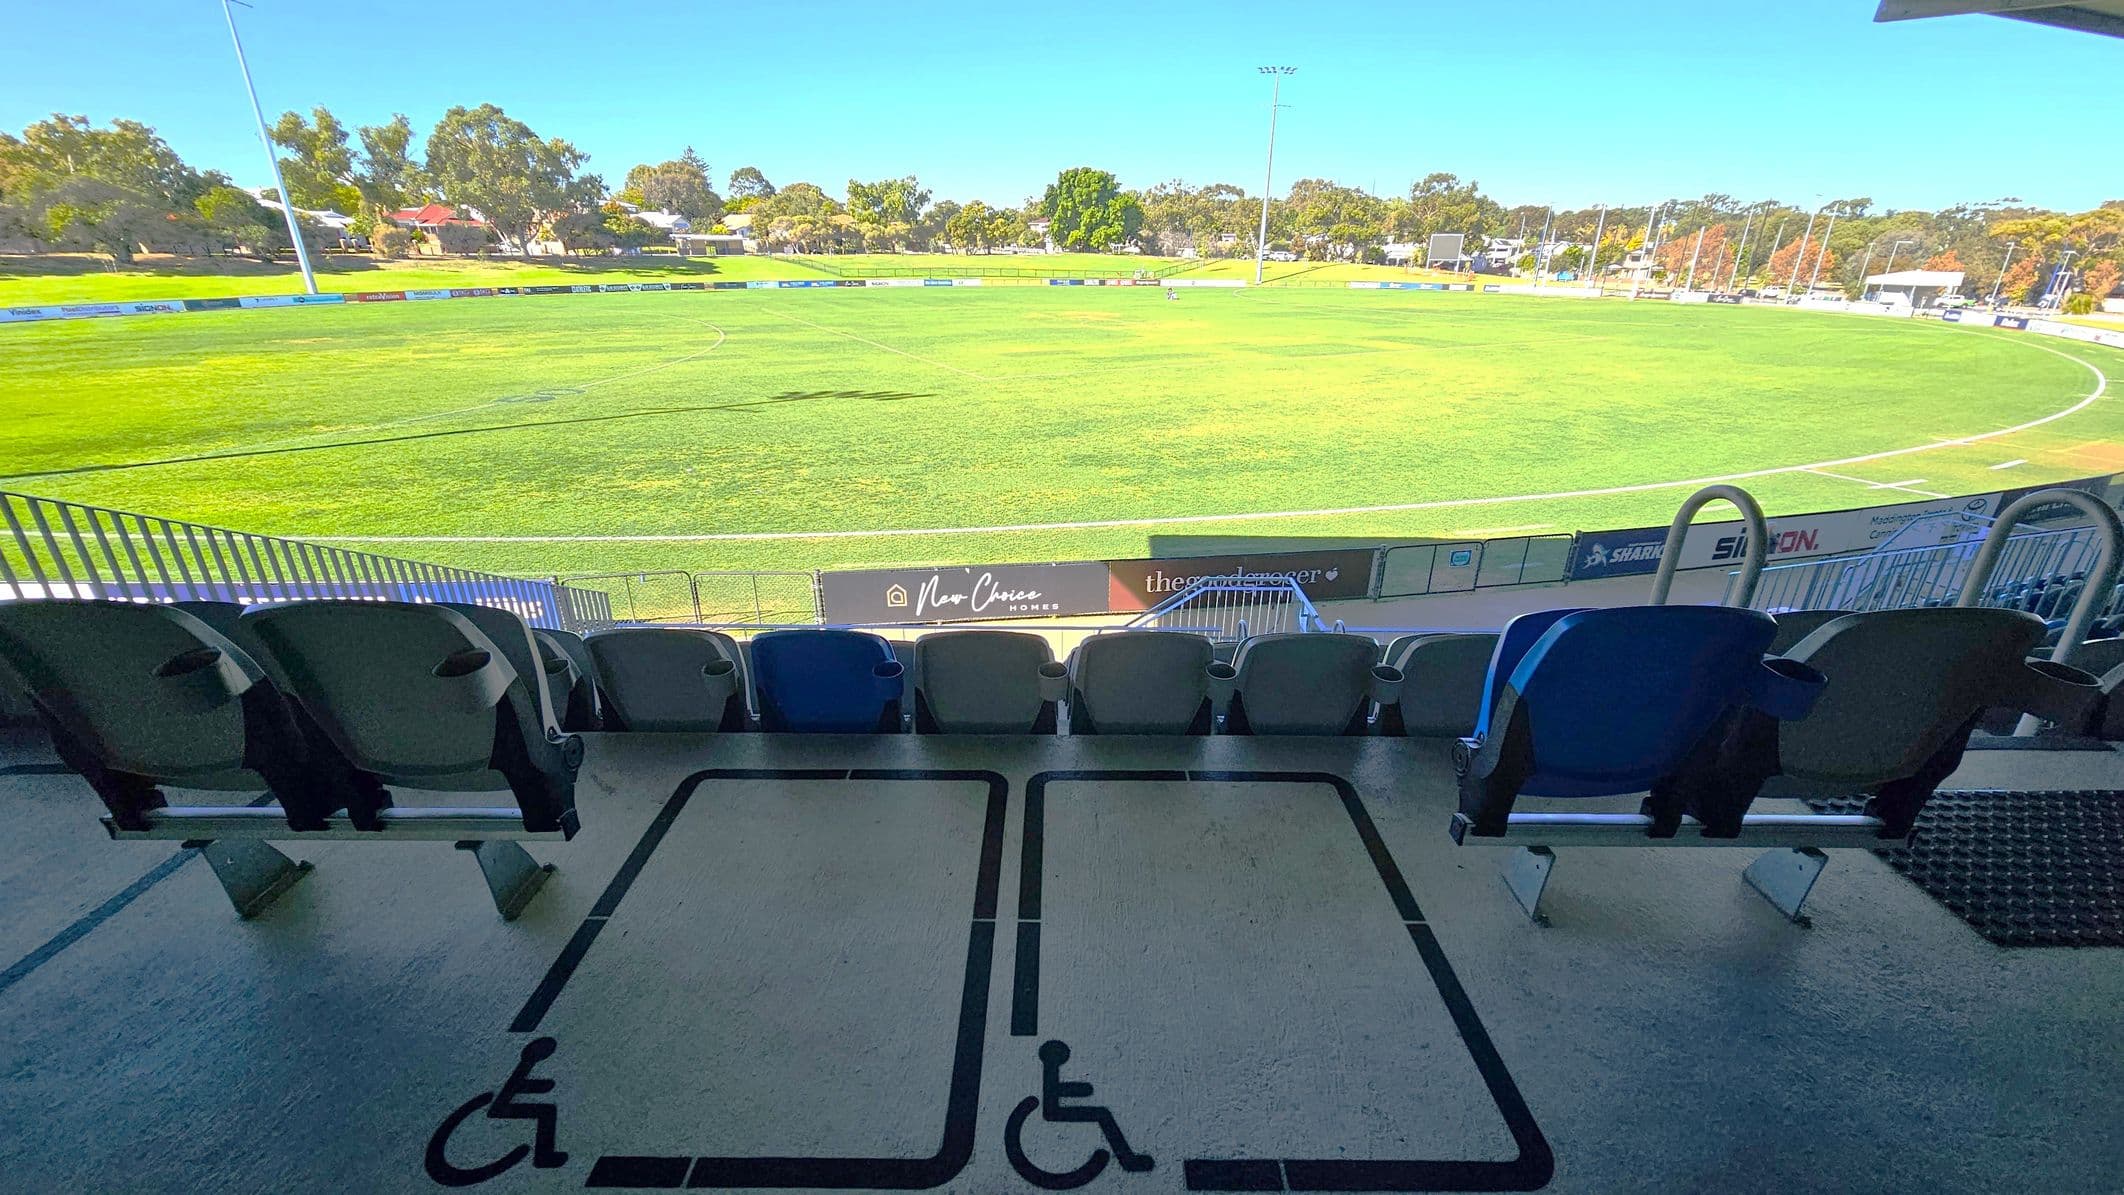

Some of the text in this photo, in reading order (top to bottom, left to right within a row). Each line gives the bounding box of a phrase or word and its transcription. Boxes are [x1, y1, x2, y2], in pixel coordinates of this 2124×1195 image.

[1609, 545, 1665, 563] SHARK
[916, 572, 1042, 616] New Choice
[1009, 603, 1059, 612] HOMES
